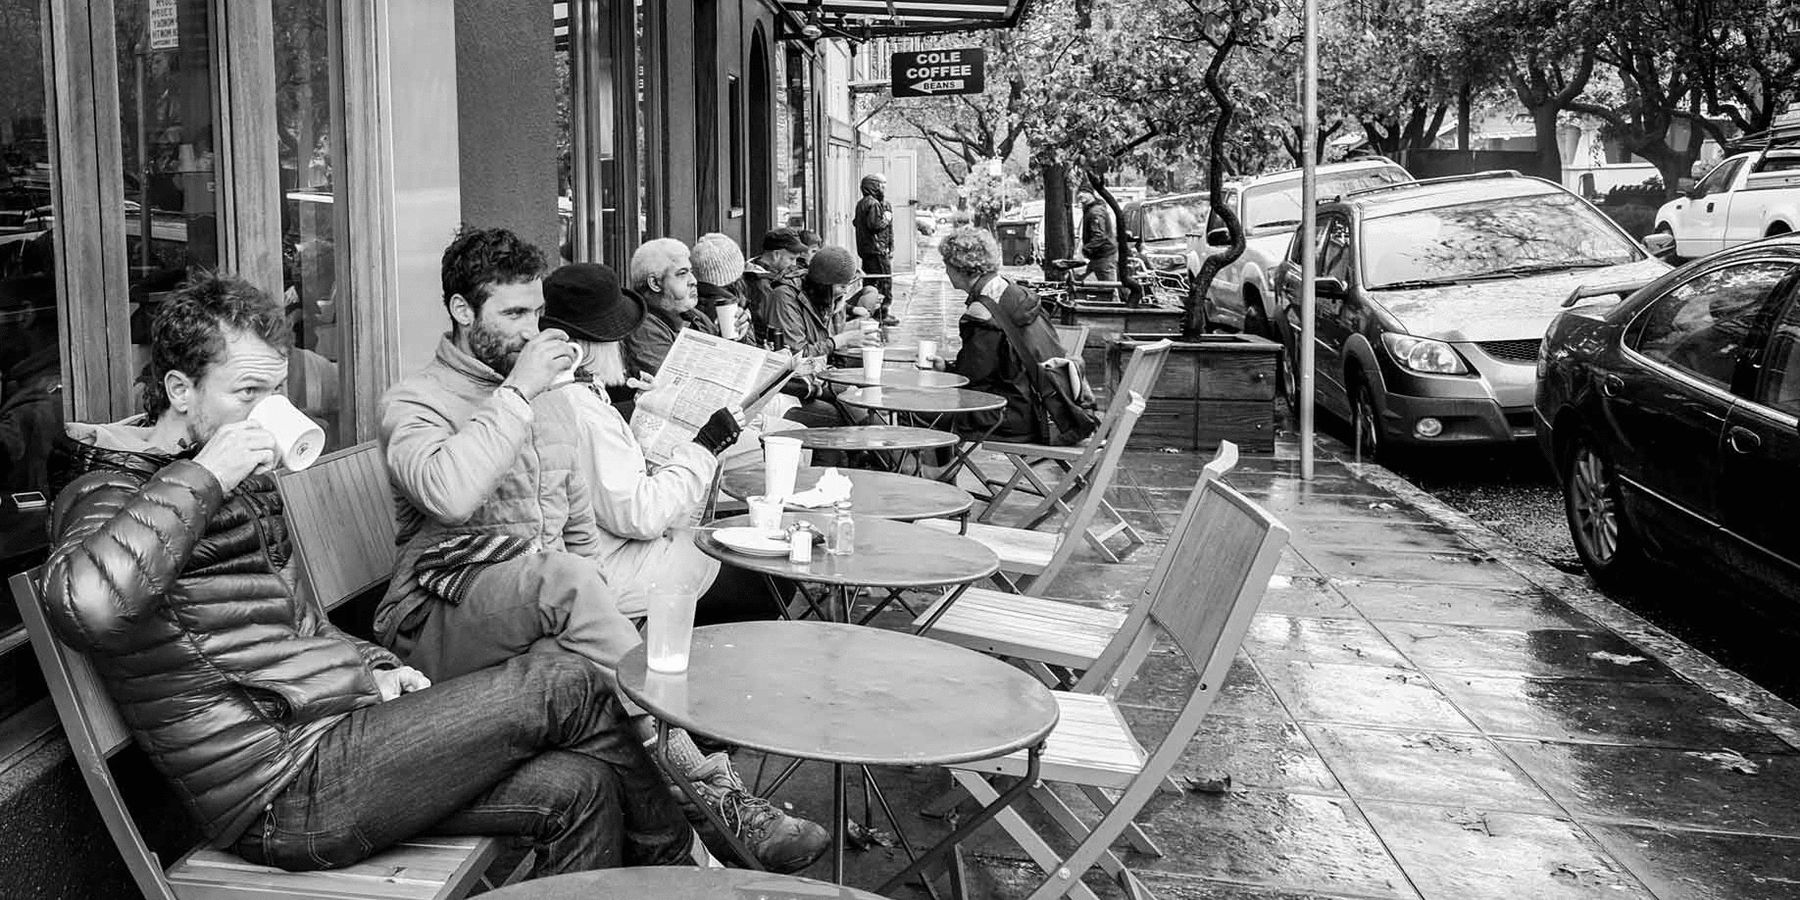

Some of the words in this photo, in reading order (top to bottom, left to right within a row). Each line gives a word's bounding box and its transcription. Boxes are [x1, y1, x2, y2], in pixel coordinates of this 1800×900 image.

[916, 51, 961, 64] COLE
[906, 65, 972, 79] COFFEE
[923, 81, 956, 90] BEANS
